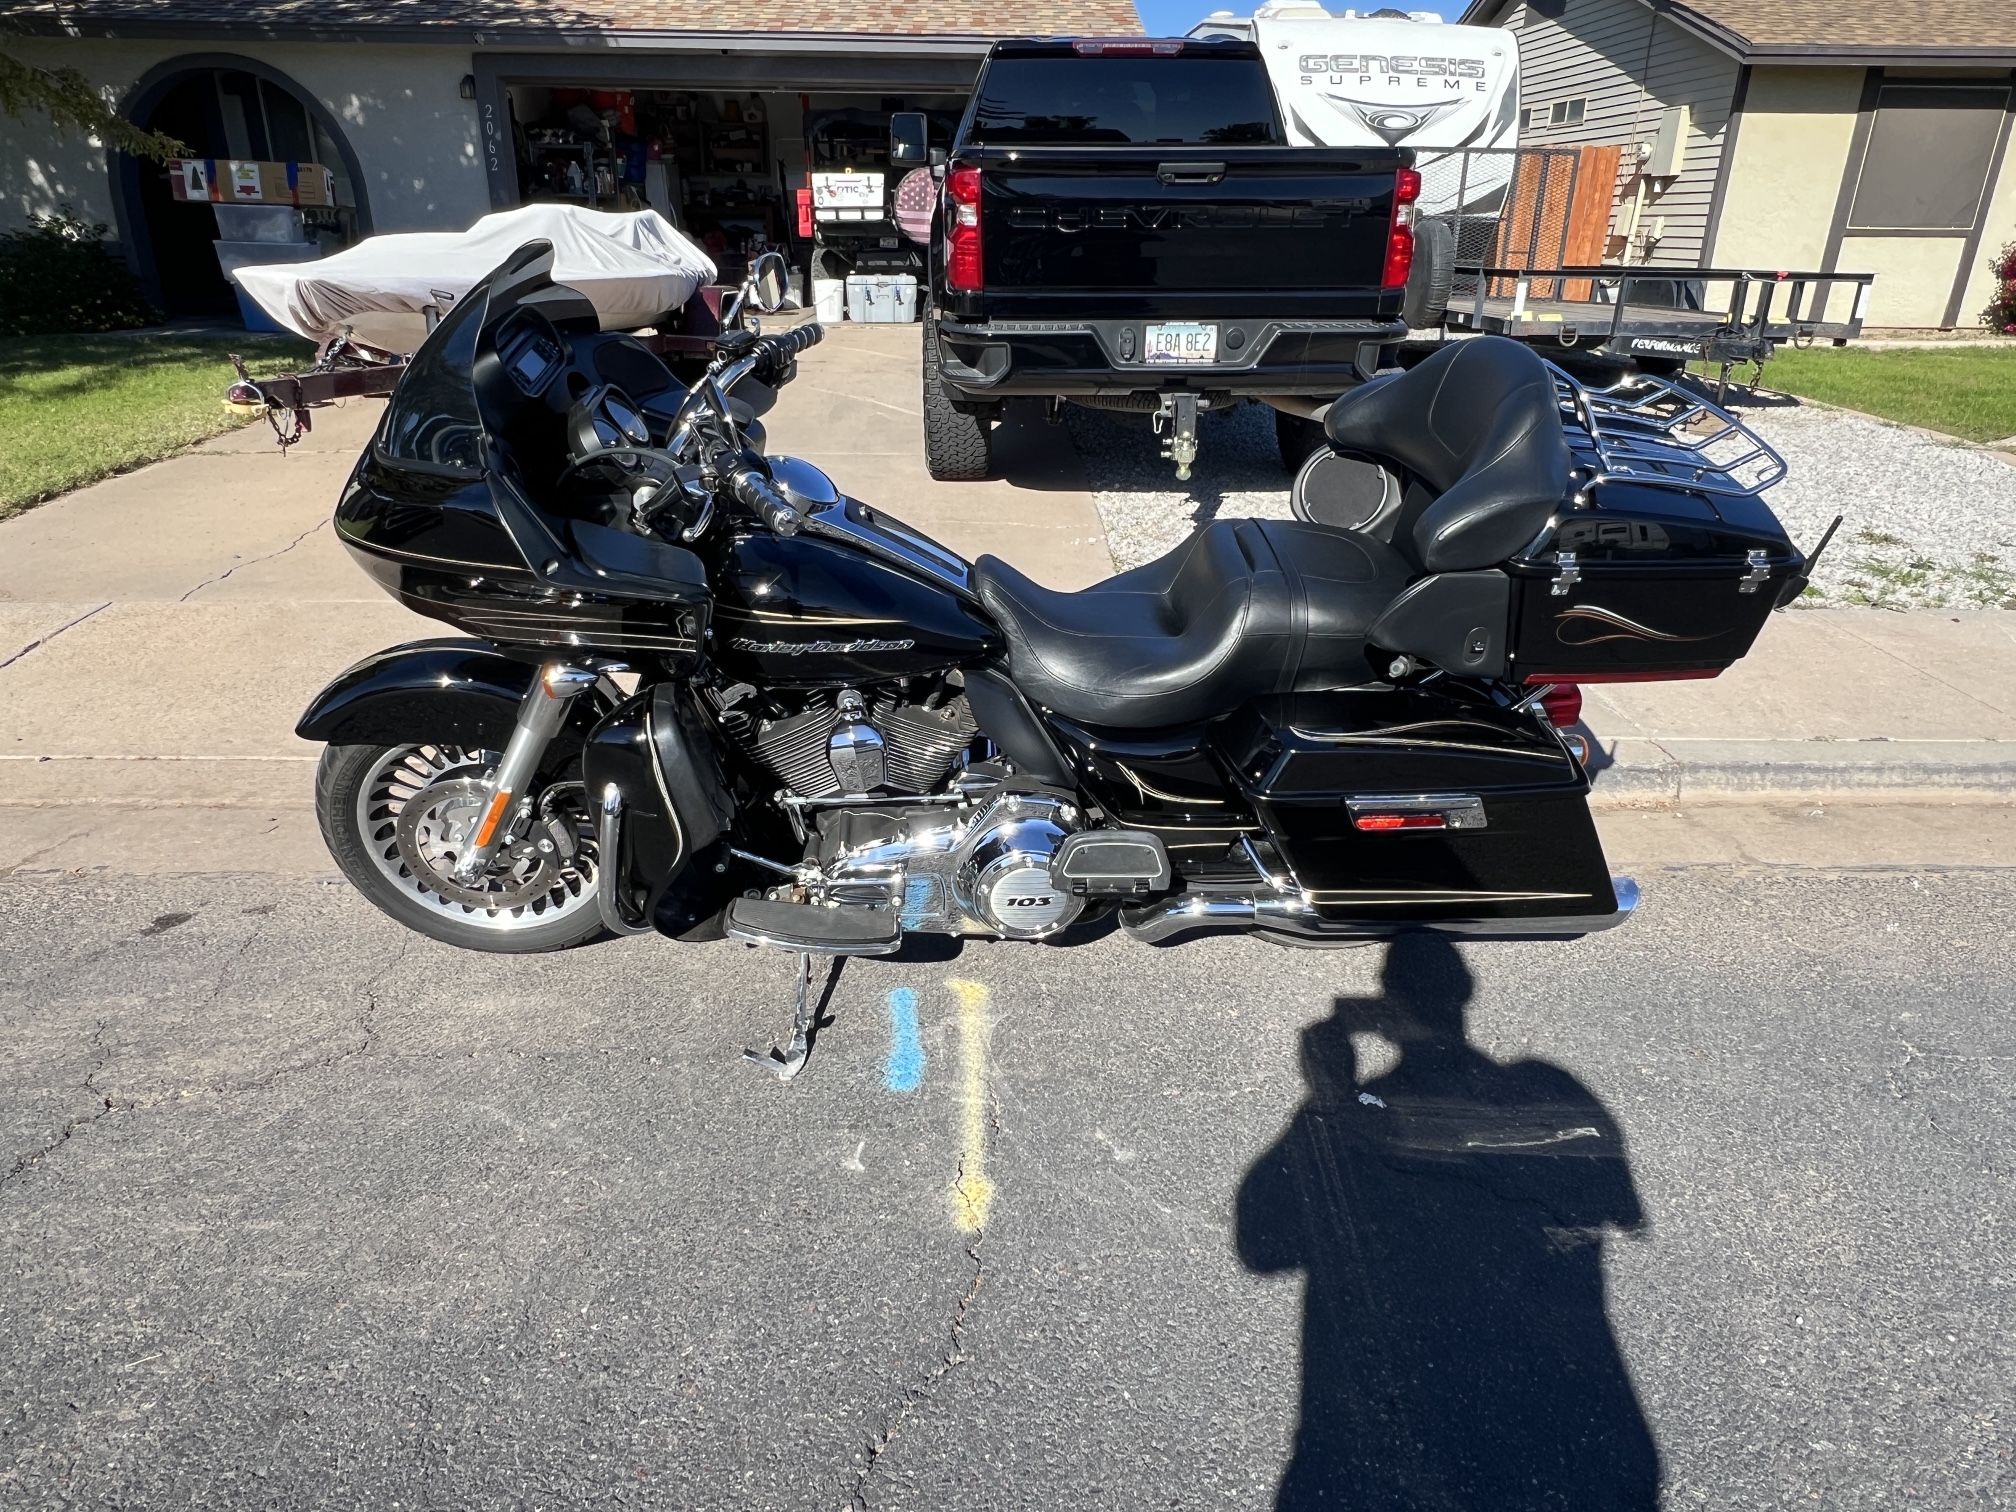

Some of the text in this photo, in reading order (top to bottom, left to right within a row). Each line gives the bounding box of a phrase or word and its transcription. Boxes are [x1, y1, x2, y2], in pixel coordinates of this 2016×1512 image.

[1299, 54, 1485, 79] GENESIS
[1301, 75, 1487, 92] SUPREME
[483, 104, 499, 172] 2062
[1007, 206, 1353, 232] CHEVROLET
[1156, 332, 1212, 352] E8A 8E2
[1629, 337, 1702, 354] PERFORMANCE
[730, 638, 916, 657] Harley-Davidson
[1006, 896, 1055, 907] 103
